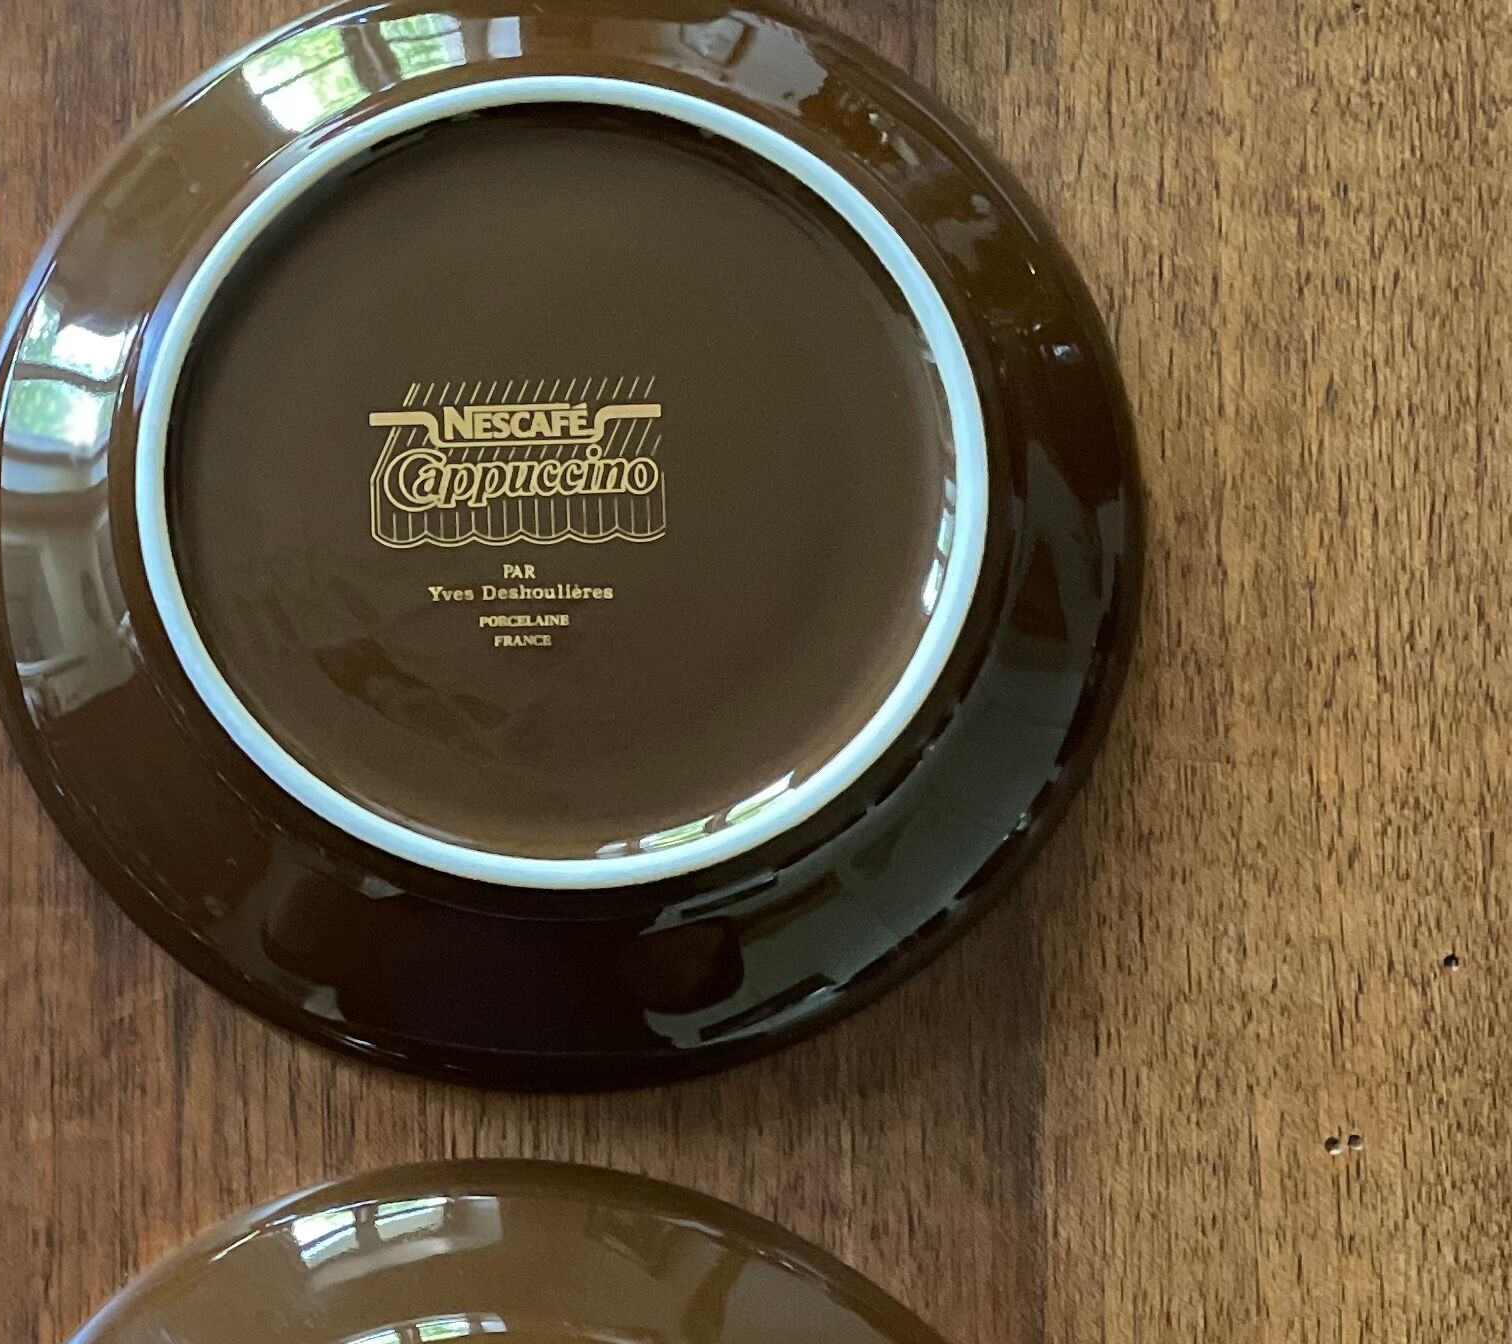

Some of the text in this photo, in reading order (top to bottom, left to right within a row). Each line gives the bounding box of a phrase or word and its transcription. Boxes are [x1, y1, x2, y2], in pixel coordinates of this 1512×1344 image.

[443, 403, 588, 440] NESCAFÉ
[384, 444, 659, 512] Cappuccino
[502, 564, 536, 579] PAR
[427, 584, 614, 602] Yves Deshoulières
[479, 615, 570, 628] PORCELAINE
[494, 635, 552, 647] FRANCE
